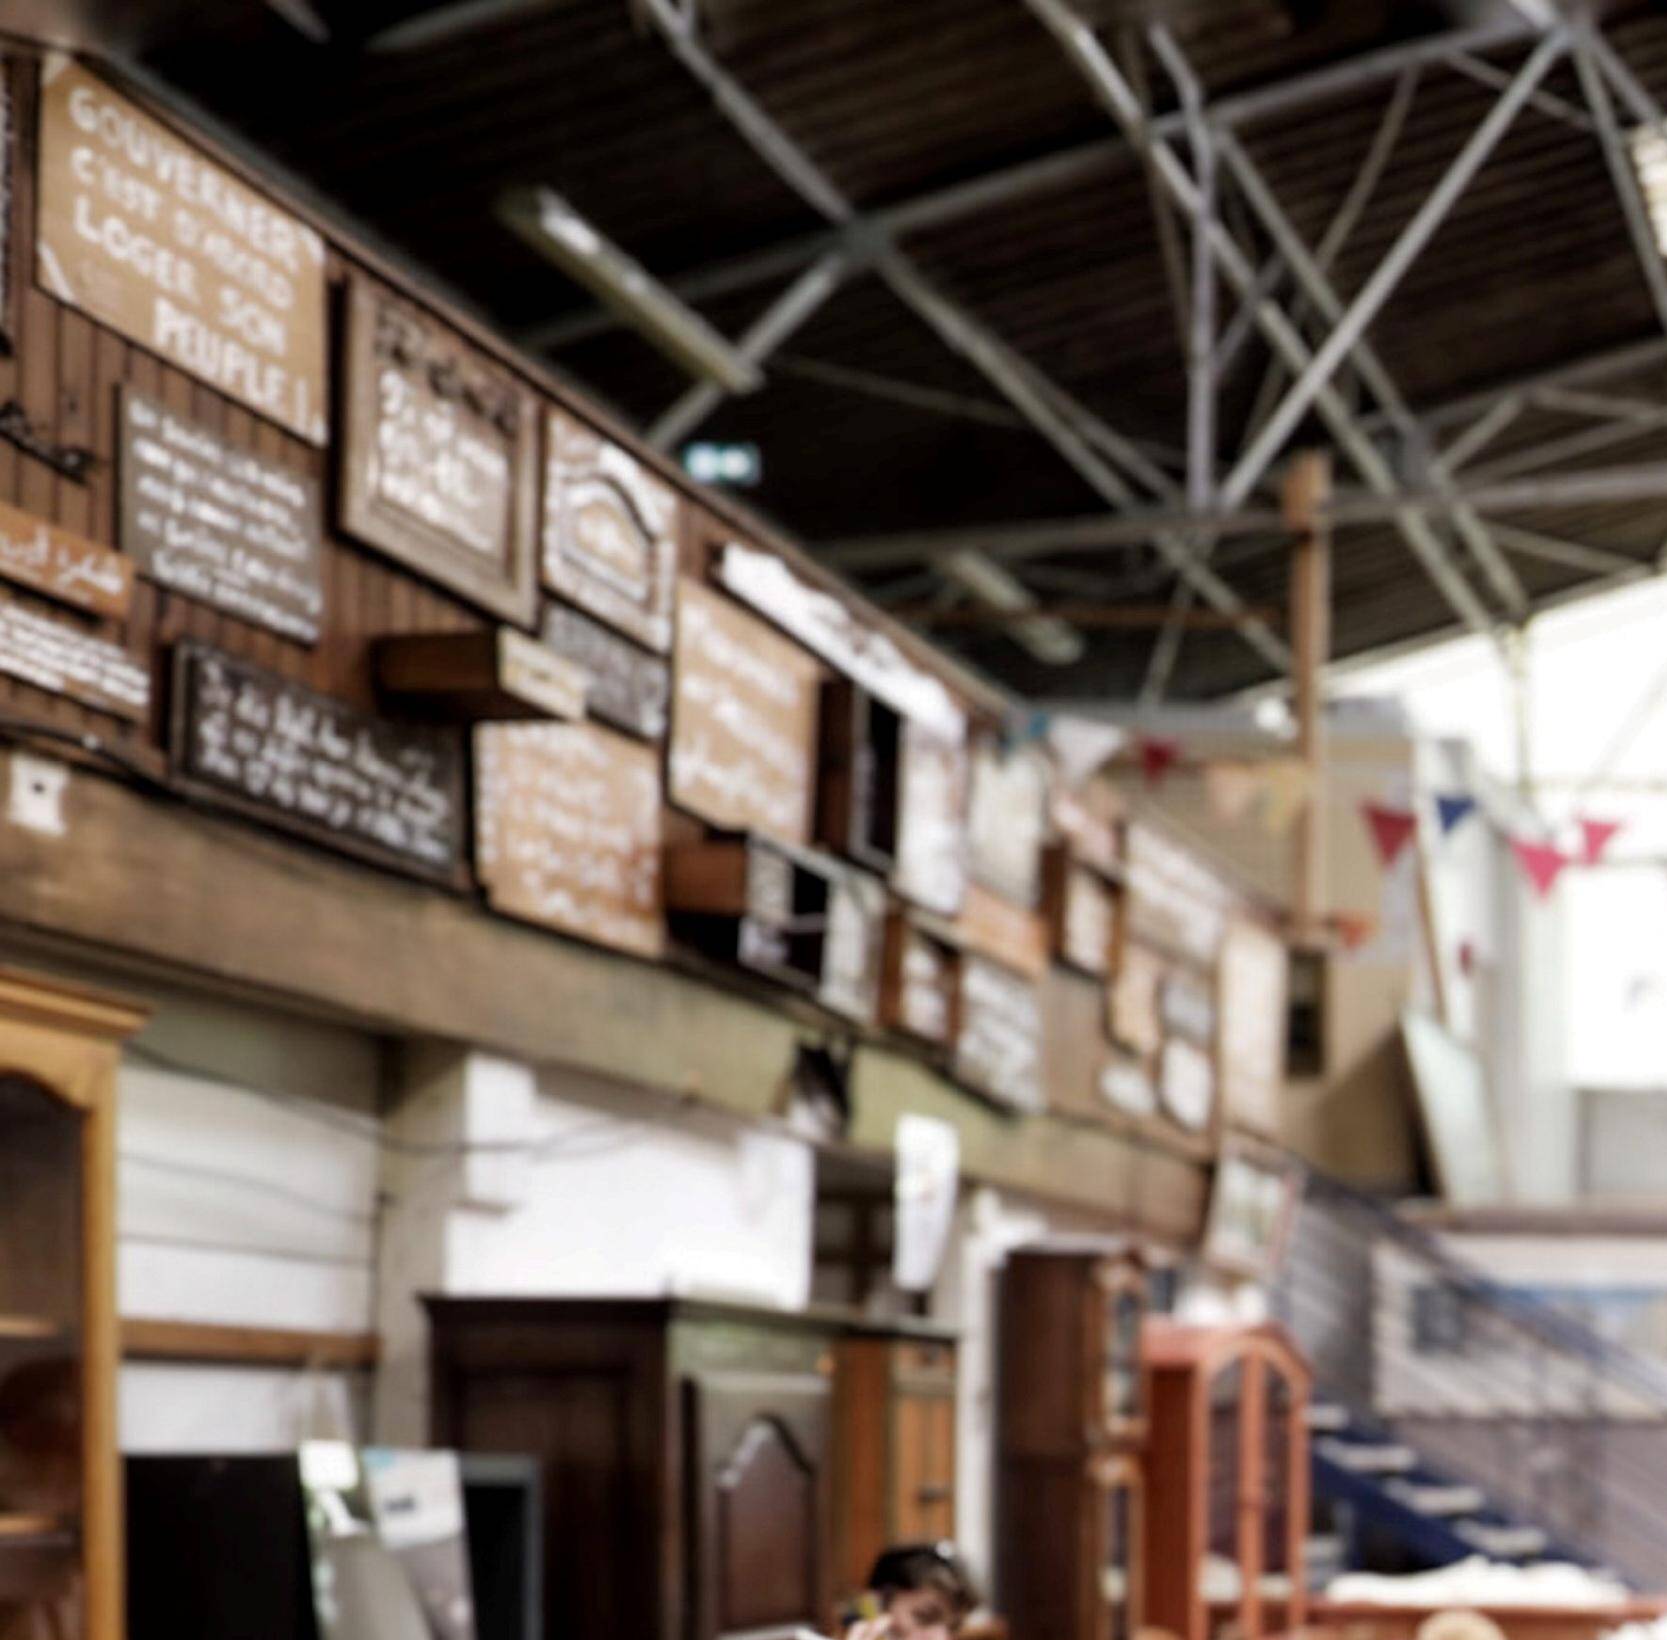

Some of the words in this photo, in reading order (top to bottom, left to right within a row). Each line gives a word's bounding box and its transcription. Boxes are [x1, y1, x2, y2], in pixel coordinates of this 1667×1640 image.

[70, 87, 298, 273] GOUVERNER
[75, 195, 200, 305] LOGER
[219, 285, 286, 357] SON
[155, 296, 286, 406] PEUPLE
